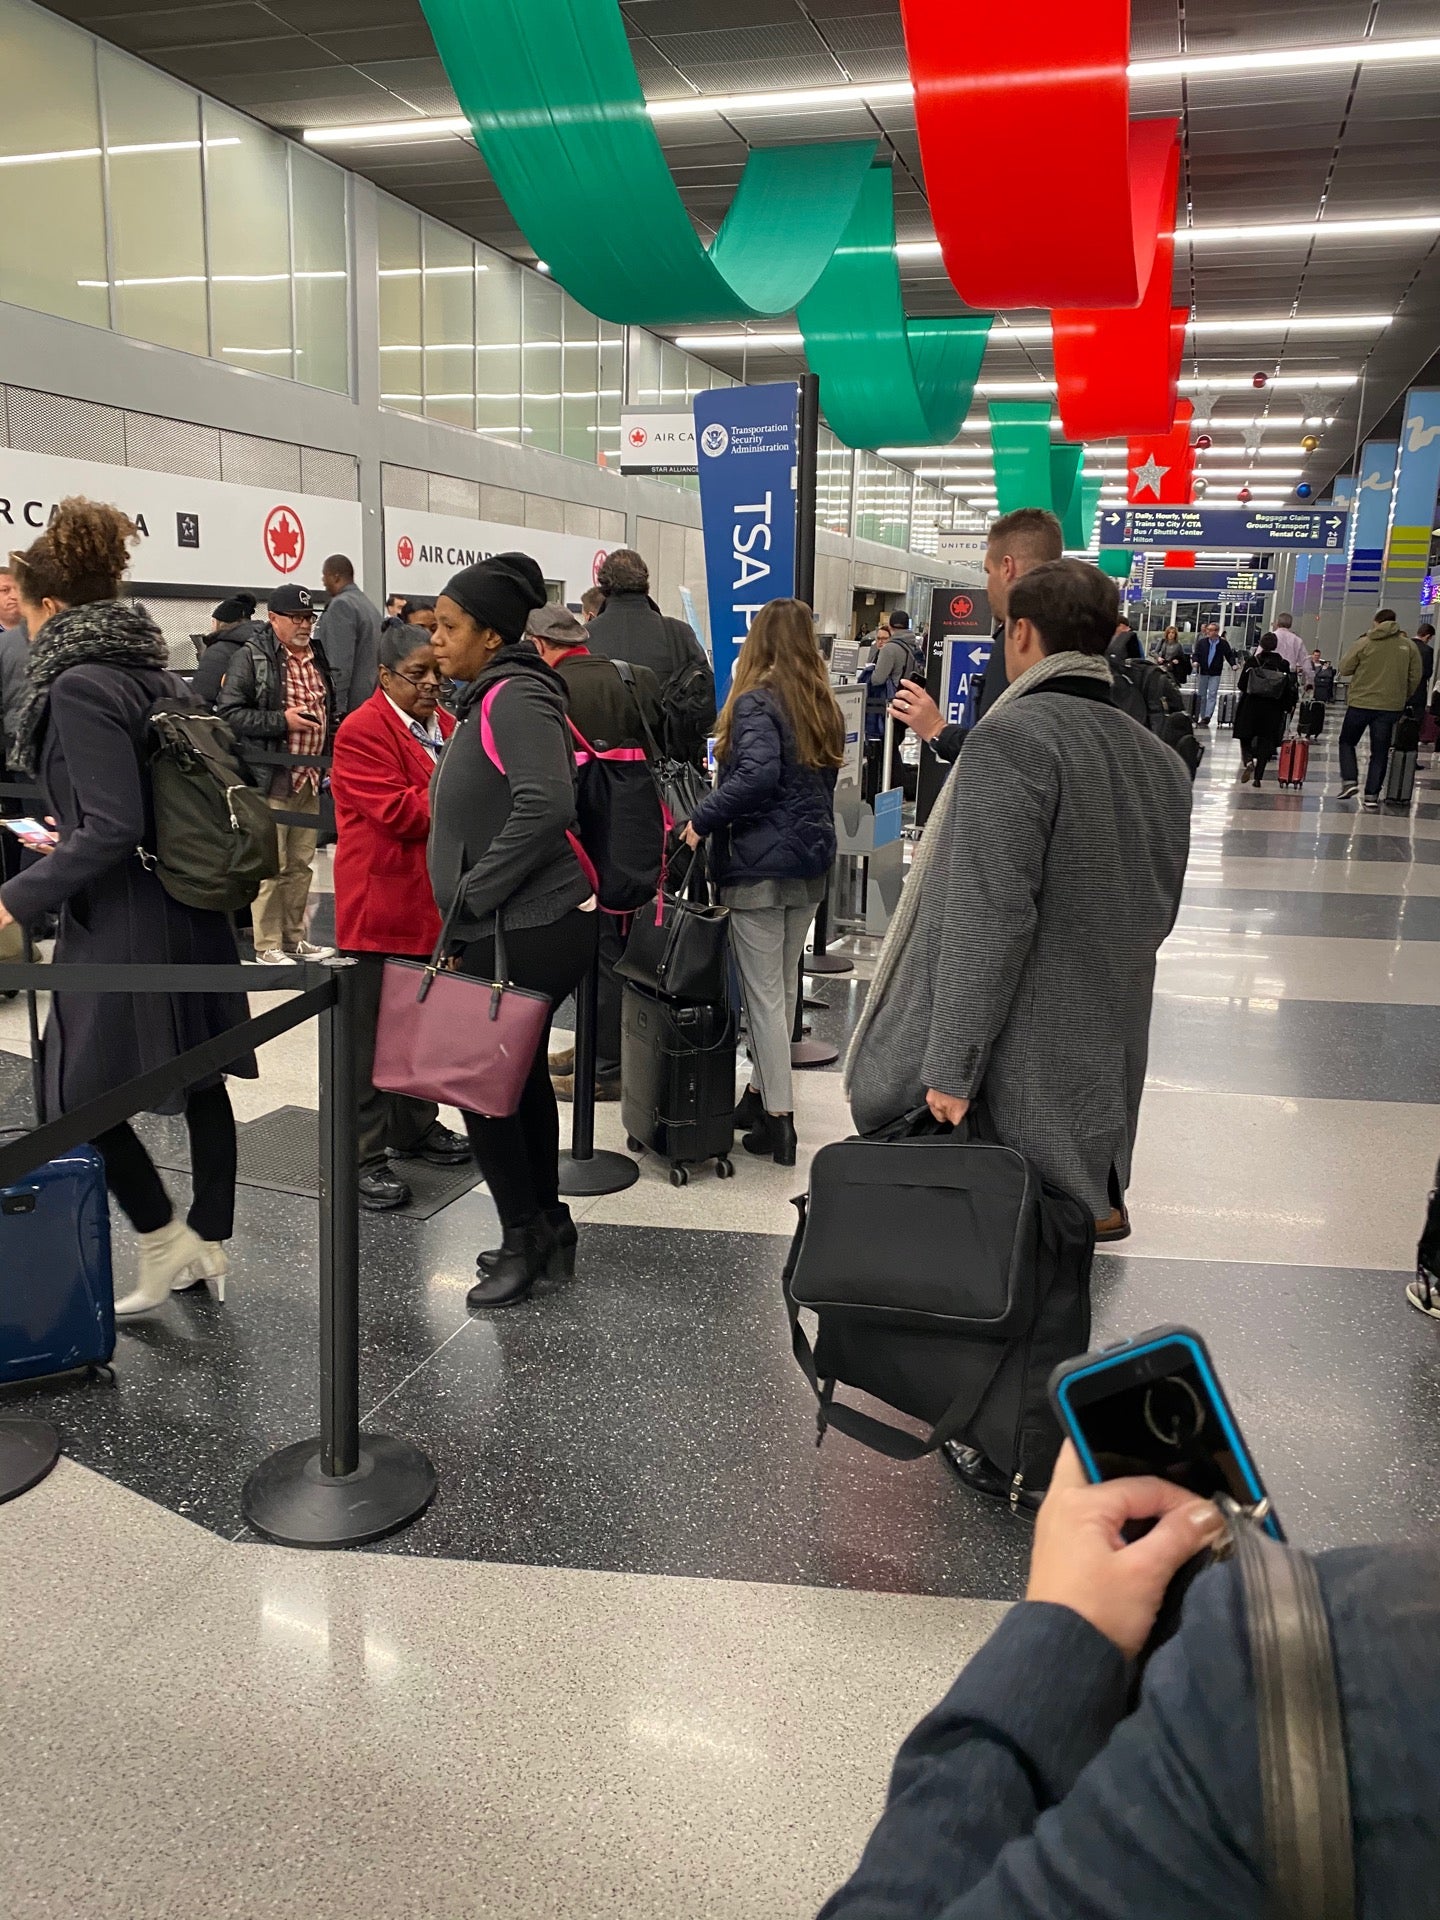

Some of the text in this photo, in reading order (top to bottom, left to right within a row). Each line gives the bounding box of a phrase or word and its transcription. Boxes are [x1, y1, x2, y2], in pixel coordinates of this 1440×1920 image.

[731, 424, 788, 435] Transportation
[655, 433, 675, 441] AIR
[731, 435, 764, 445] Security
[731, 443, 789, 454] Administration
[1135, 512, 1155, 520] Daily,
[1155, 512, 1181, 520] Hourly,
[1274, 522, 1310, 530] Transport
[733, 491, 772, 590] TSA
[419, 544, 444, 564] AIR
